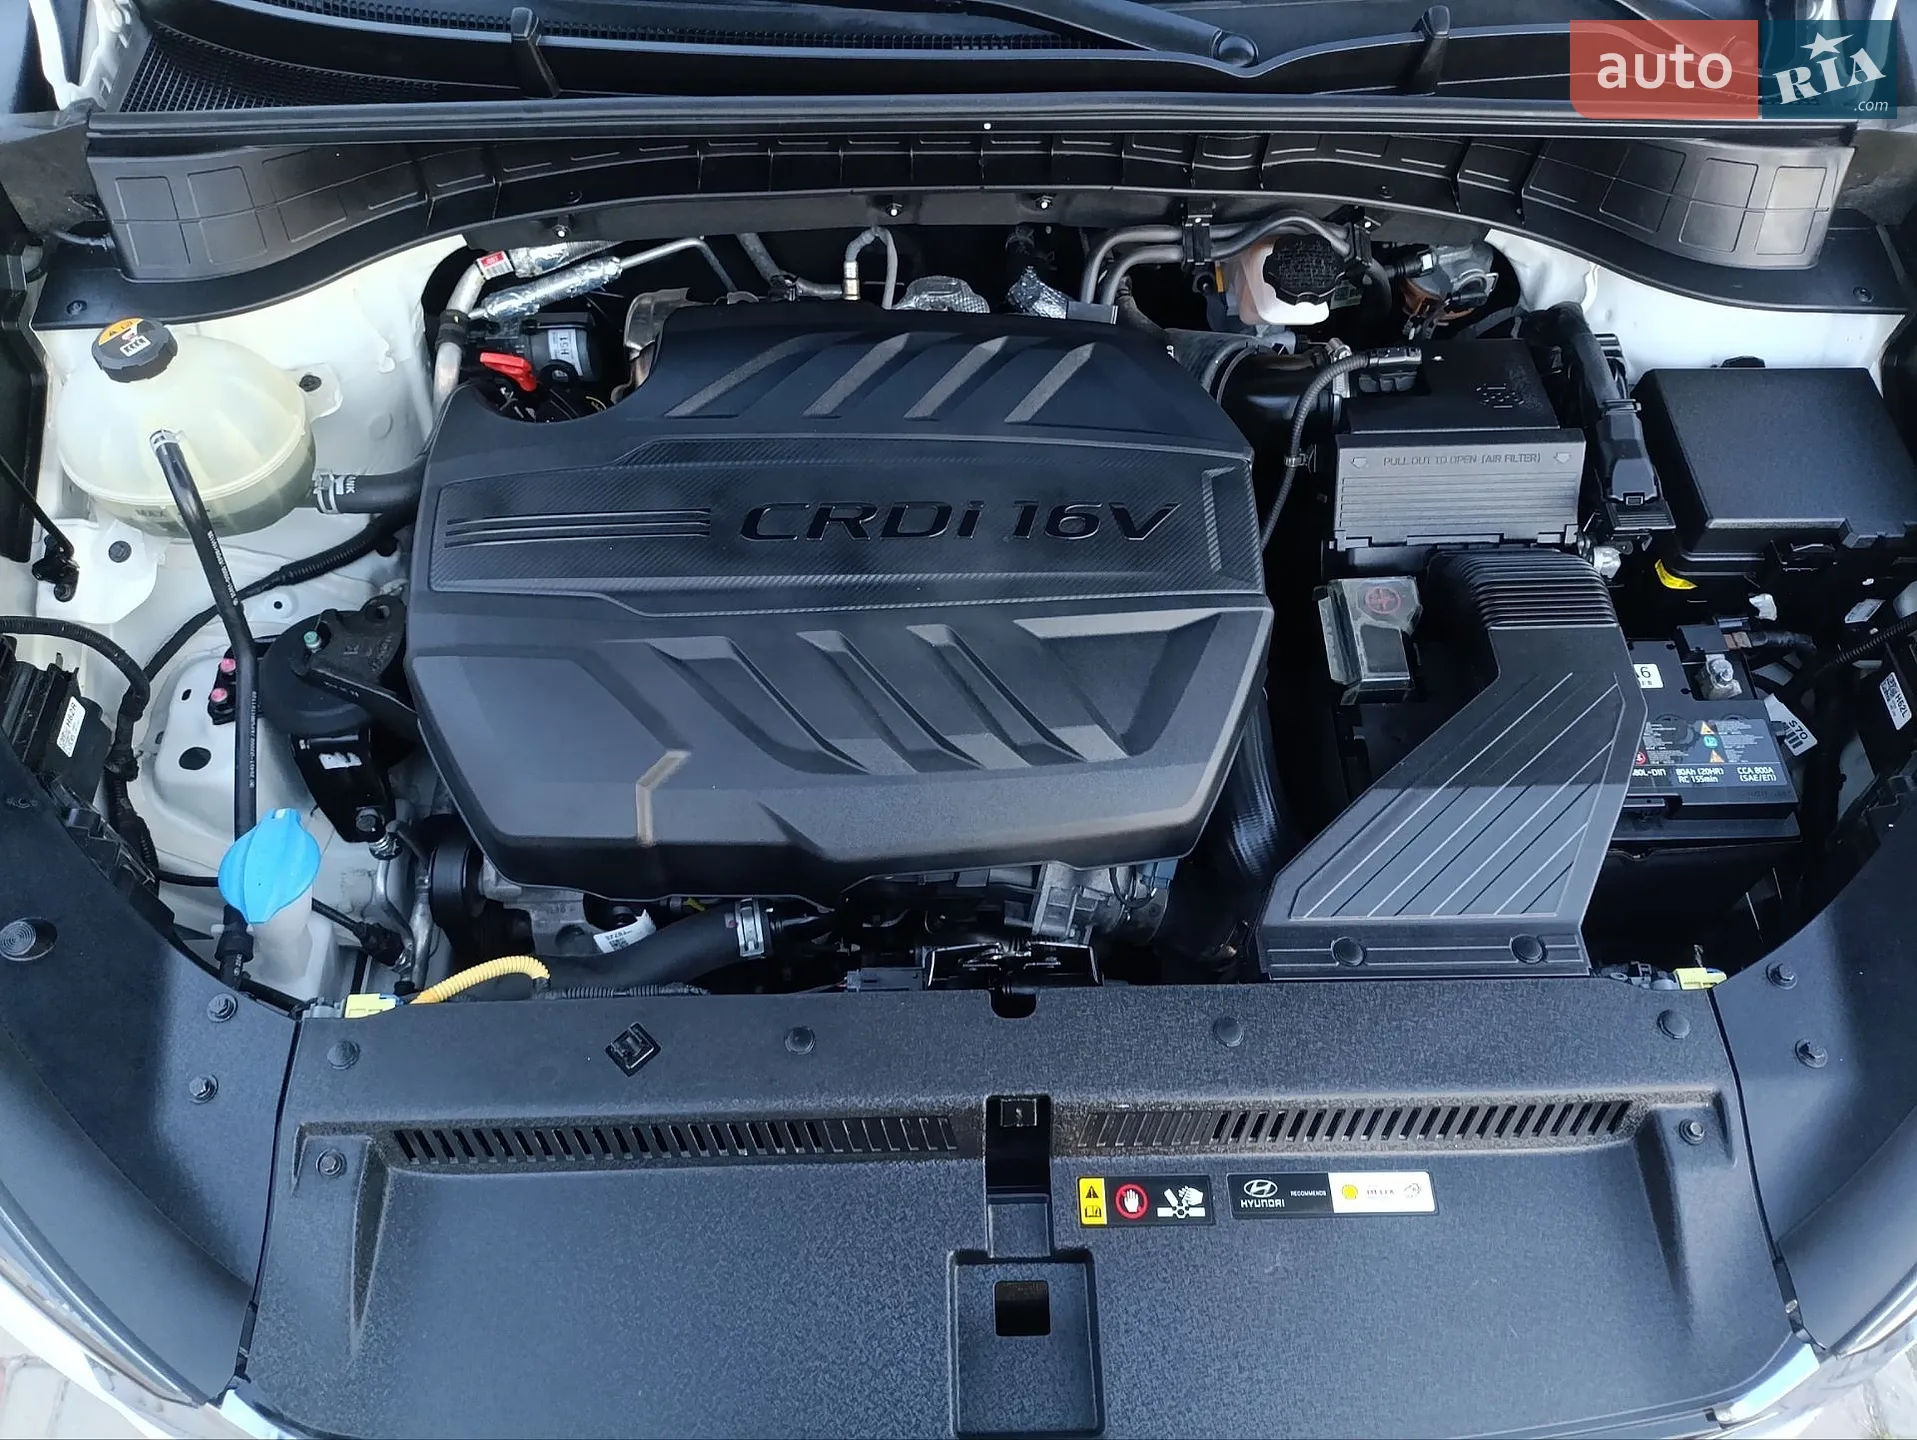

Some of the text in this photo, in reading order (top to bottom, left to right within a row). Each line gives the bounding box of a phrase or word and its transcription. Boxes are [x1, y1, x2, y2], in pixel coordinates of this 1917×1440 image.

[1383, 456, 1409, 467] PULL
[1411, 456, 1431, 466] OUT
[1435, 455, 1447, 465] TO
[1450, 454, 1478, 465] OPEN
[740, 500, 1182, 541] CRDi 16V
[1788, 719, 1808, 741] S70
[1736, 767, 1754, 775] CCA
[1240, 1198, 1286, 1209] HYUNDAI
